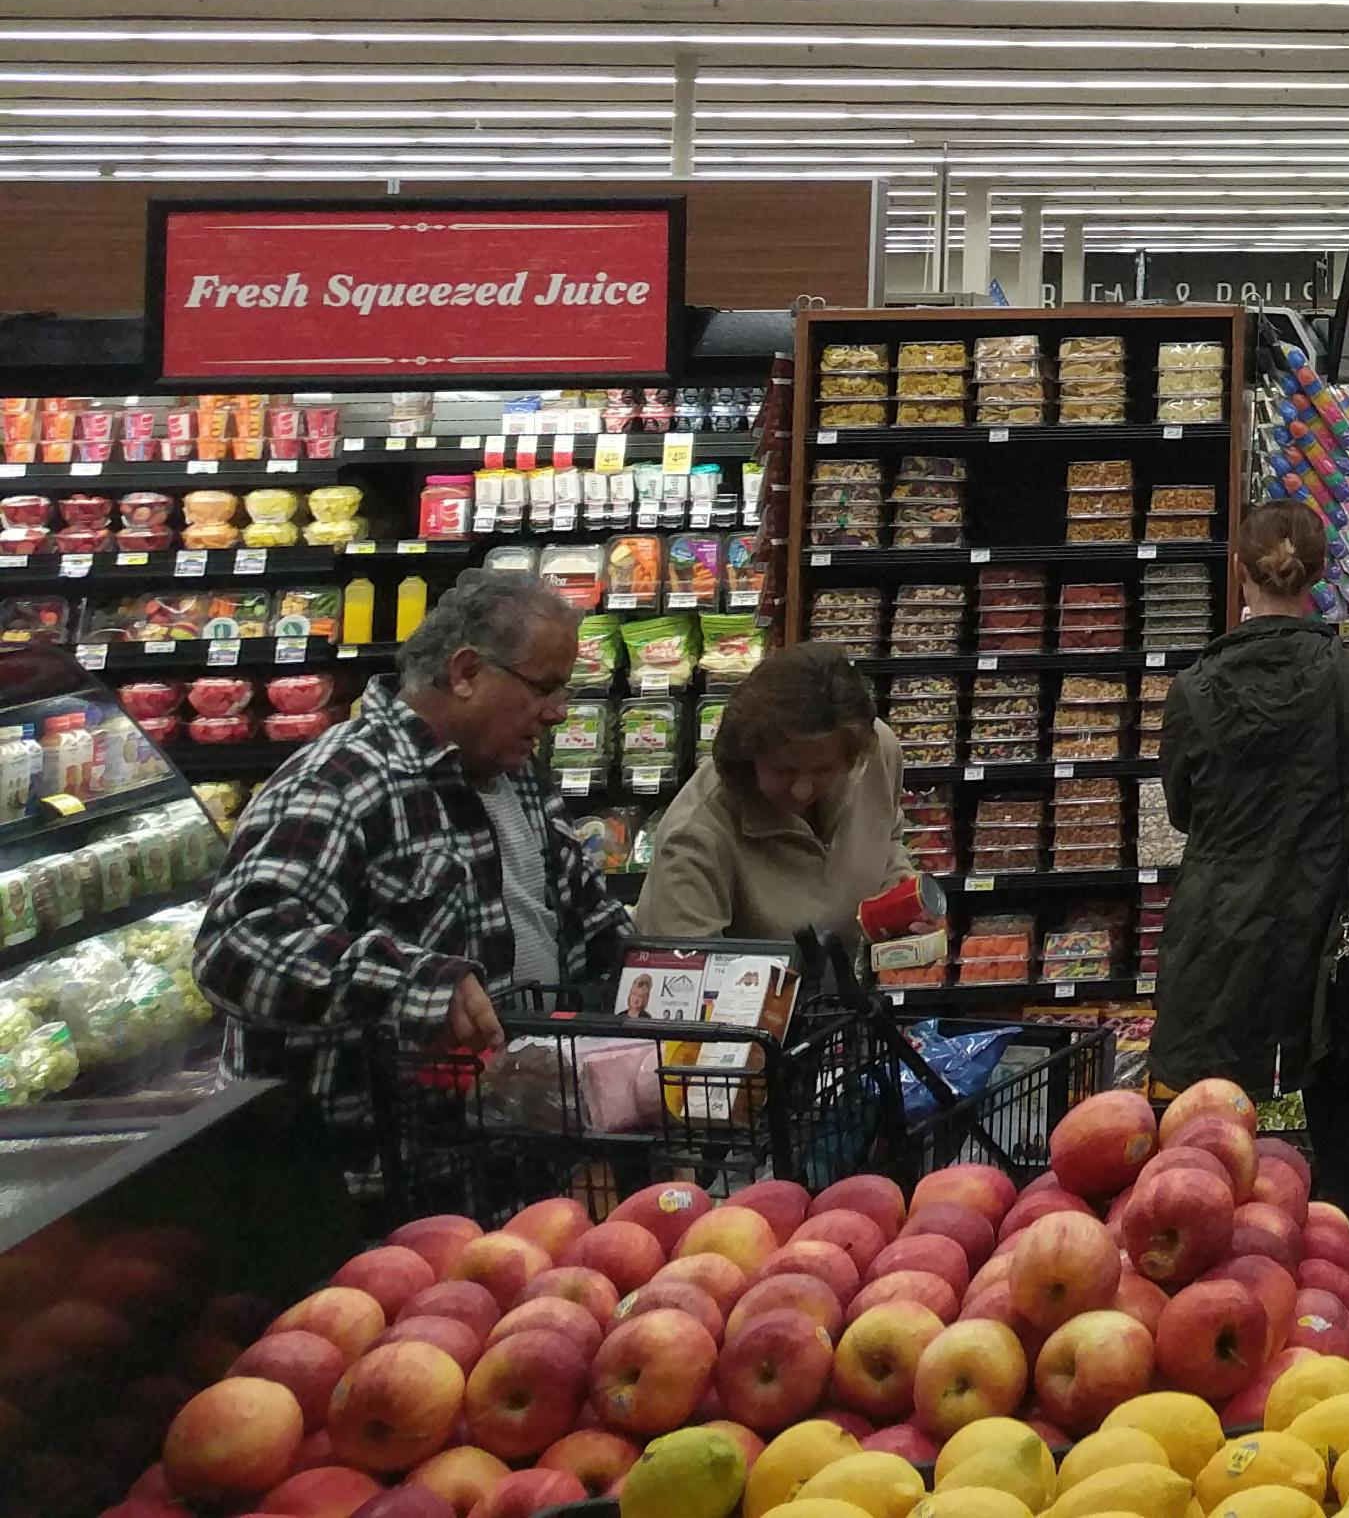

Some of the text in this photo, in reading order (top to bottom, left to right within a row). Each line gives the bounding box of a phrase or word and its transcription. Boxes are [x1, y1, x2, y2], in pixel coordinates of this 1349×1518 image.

[184, 271, 651, 316] Fresh Squeezed Juice
